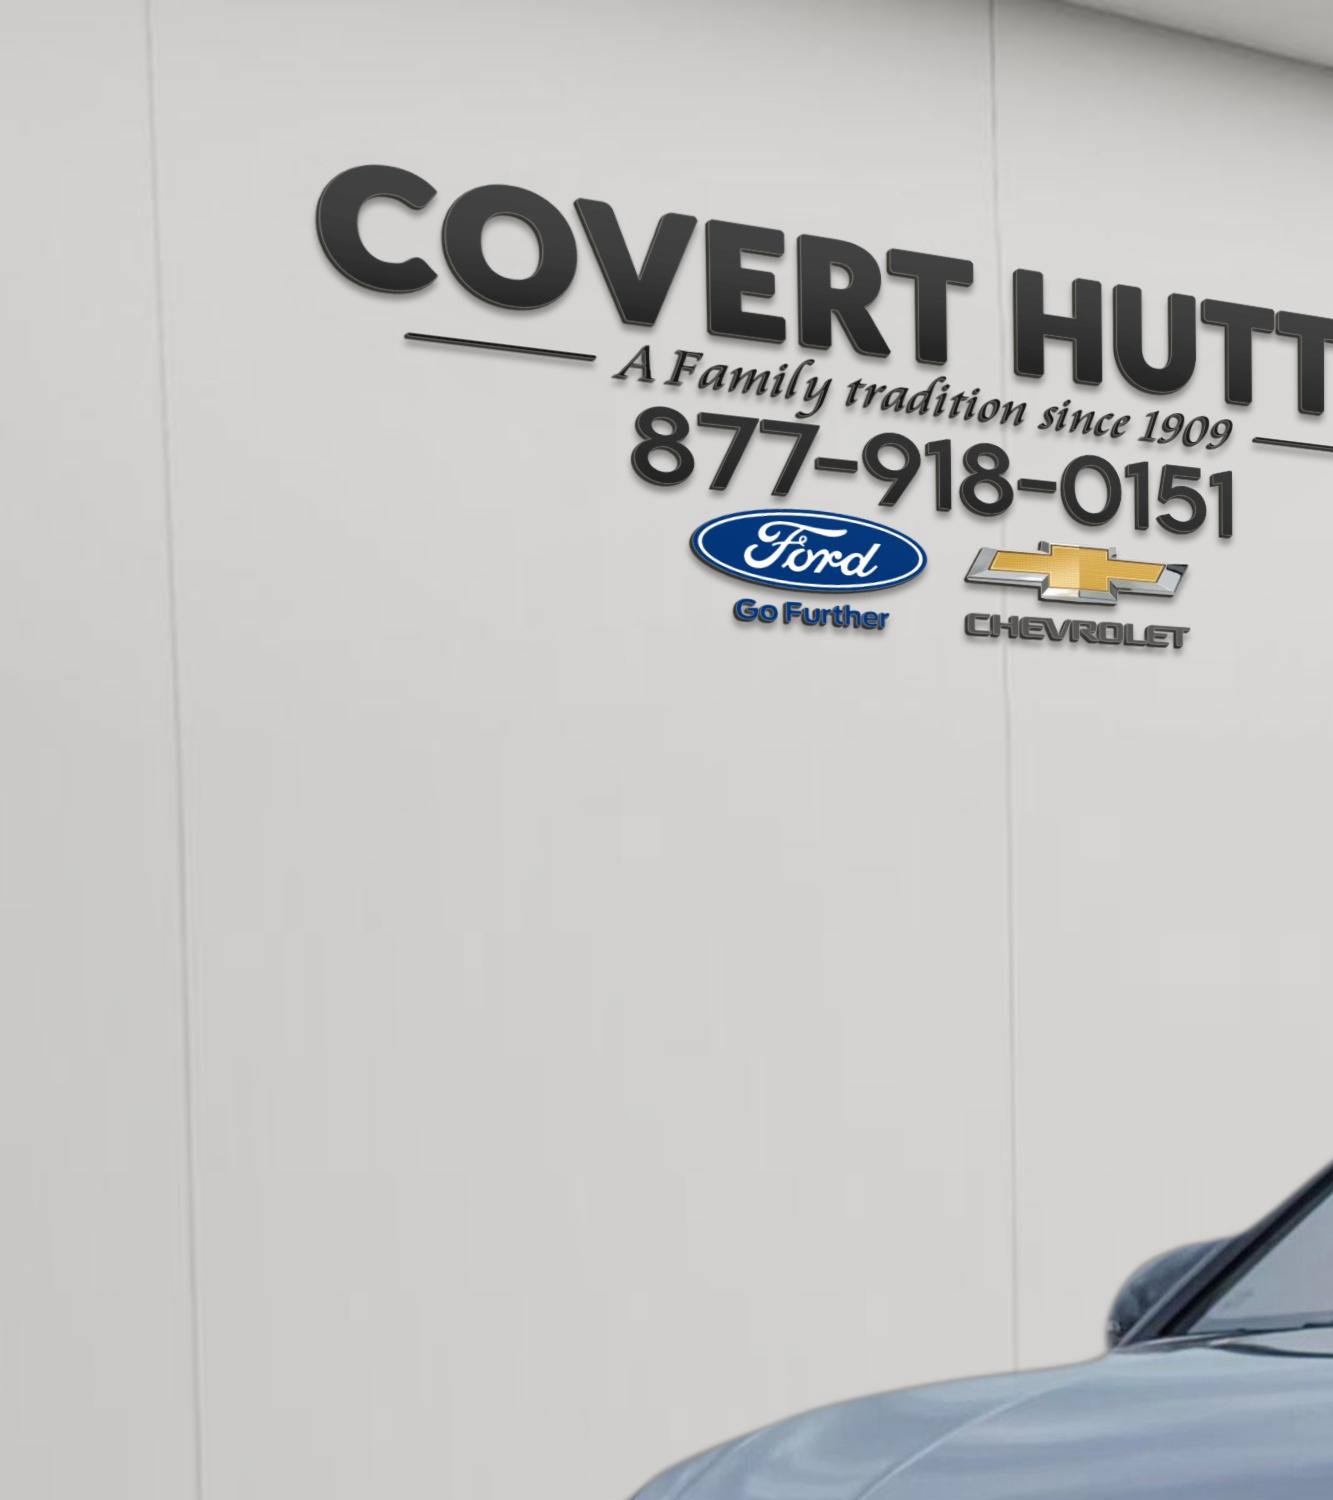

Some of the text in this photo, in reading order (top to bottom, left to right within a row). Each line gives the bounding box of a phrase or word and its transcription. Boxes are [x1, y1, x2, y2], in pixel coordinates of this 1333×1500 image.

[315, 164, 973, 364] COVERT
[612, 345, 1232, 449] A Family tradition since 1909
[630, 406, 1233, 539] 877-918-0151
[743, 520, 881, 578] Ford
[733, 598, 890, 630] Go Further
[964, 613, 1190, 648] CHEVROLET
